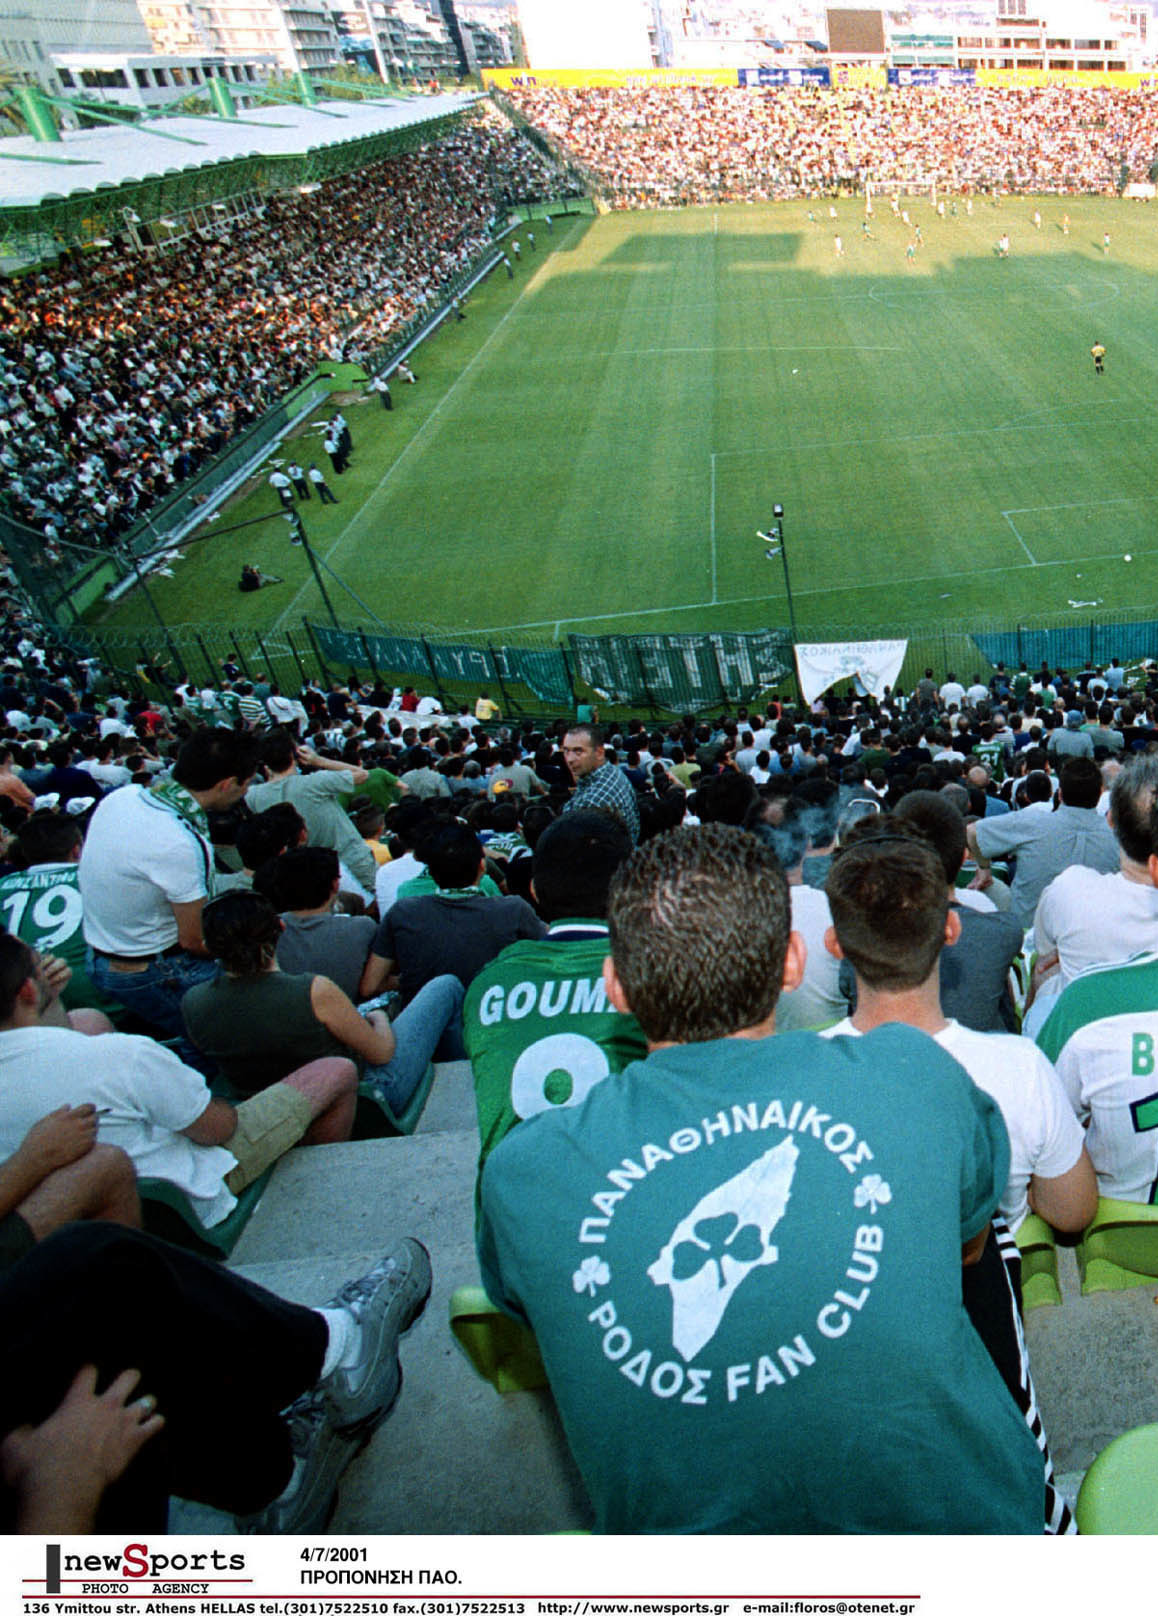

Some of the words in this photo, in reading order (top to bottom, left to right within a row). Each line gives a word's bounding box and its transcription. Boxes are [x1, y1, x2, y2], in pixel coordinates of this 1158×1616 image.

[3, 884, 84, 948] 19
[479, 977, 617, 1026] GOUM
[579, 1099, 874, 1244] ΠΑΝΑΘΗΝΑΙΚΟΣ
[587, 1299, 712, 1405] ΡΟΔΟΣ
[726, 1335, 817, 1403] FAN
[816, 1224, 885, 1340] CLUB
